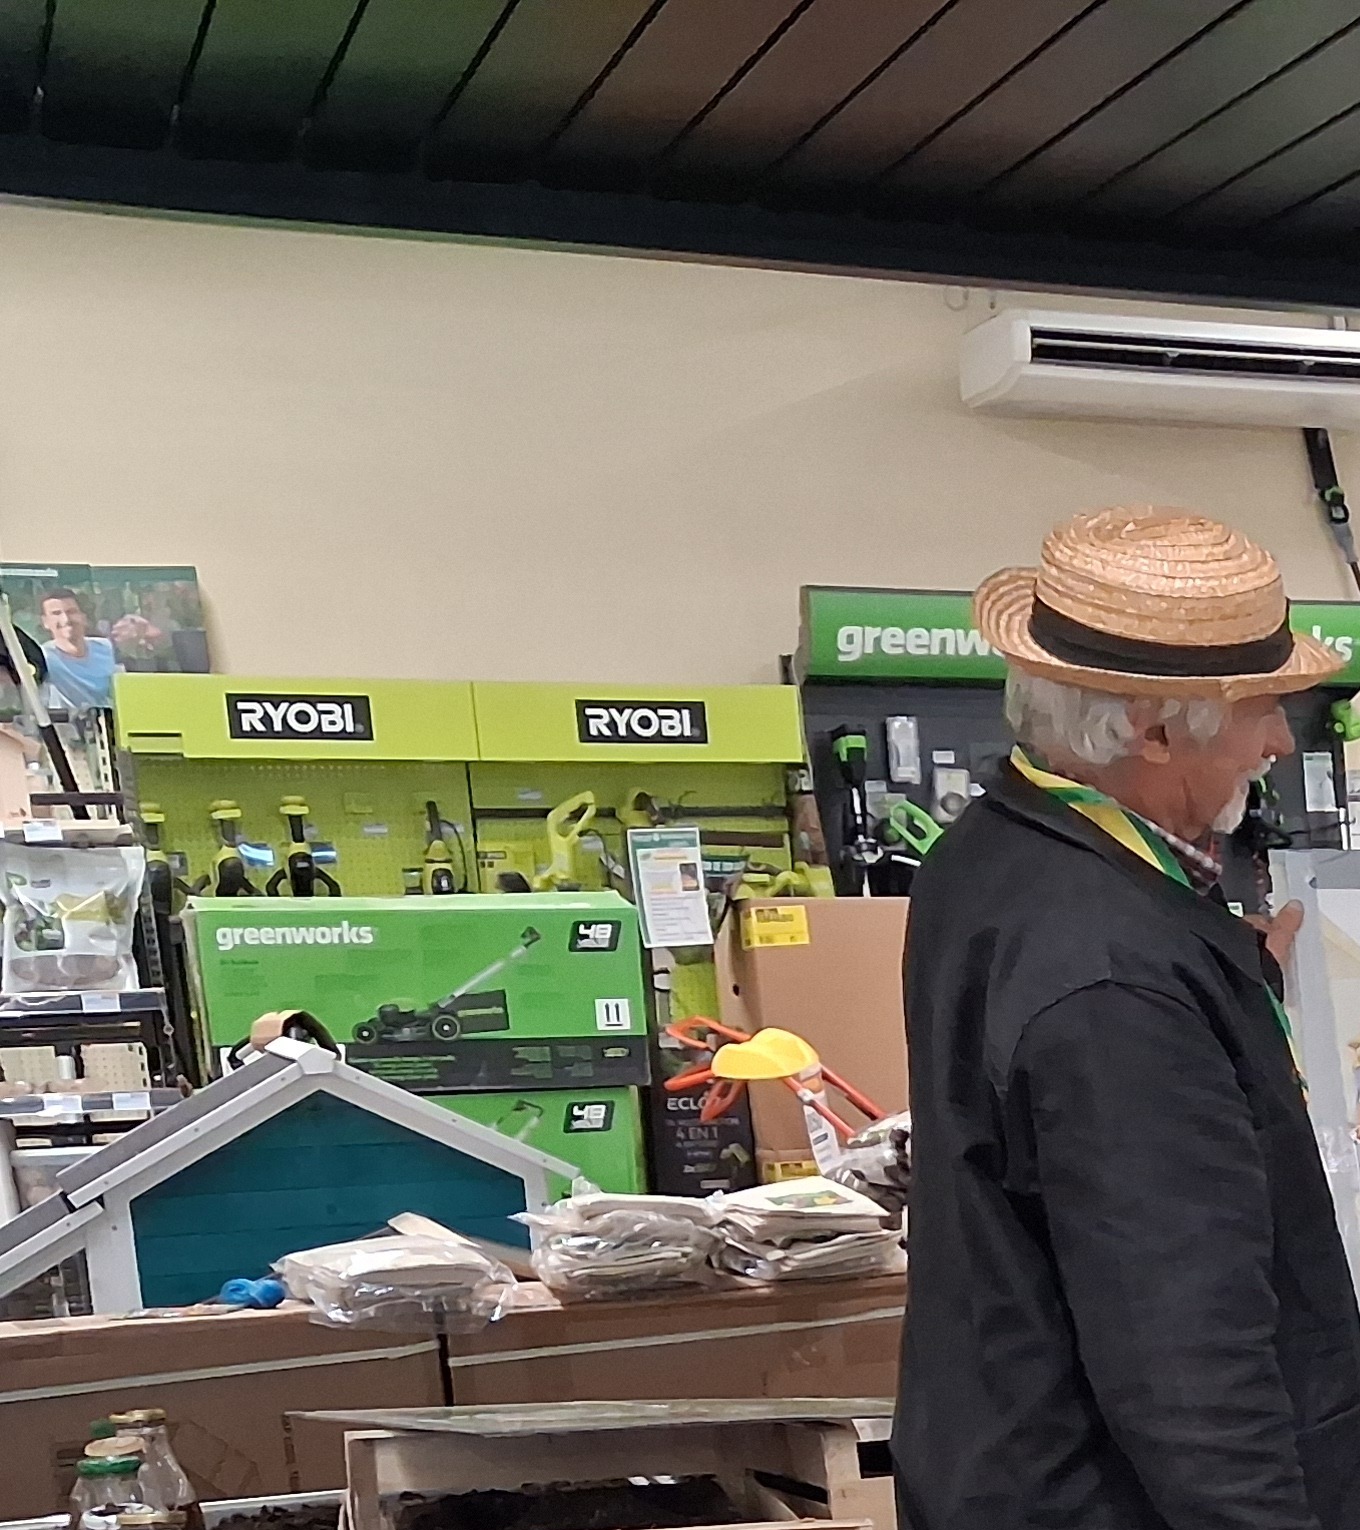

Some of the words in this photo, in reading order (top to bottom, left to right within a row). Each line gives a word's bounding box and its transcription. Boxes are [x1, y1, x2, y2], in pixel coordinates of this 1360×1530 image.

[236, 702, 355, 734] RYOBI
[584, 707, 694, 738] RYOBI
[216, 921, 373, 950] greenworks
